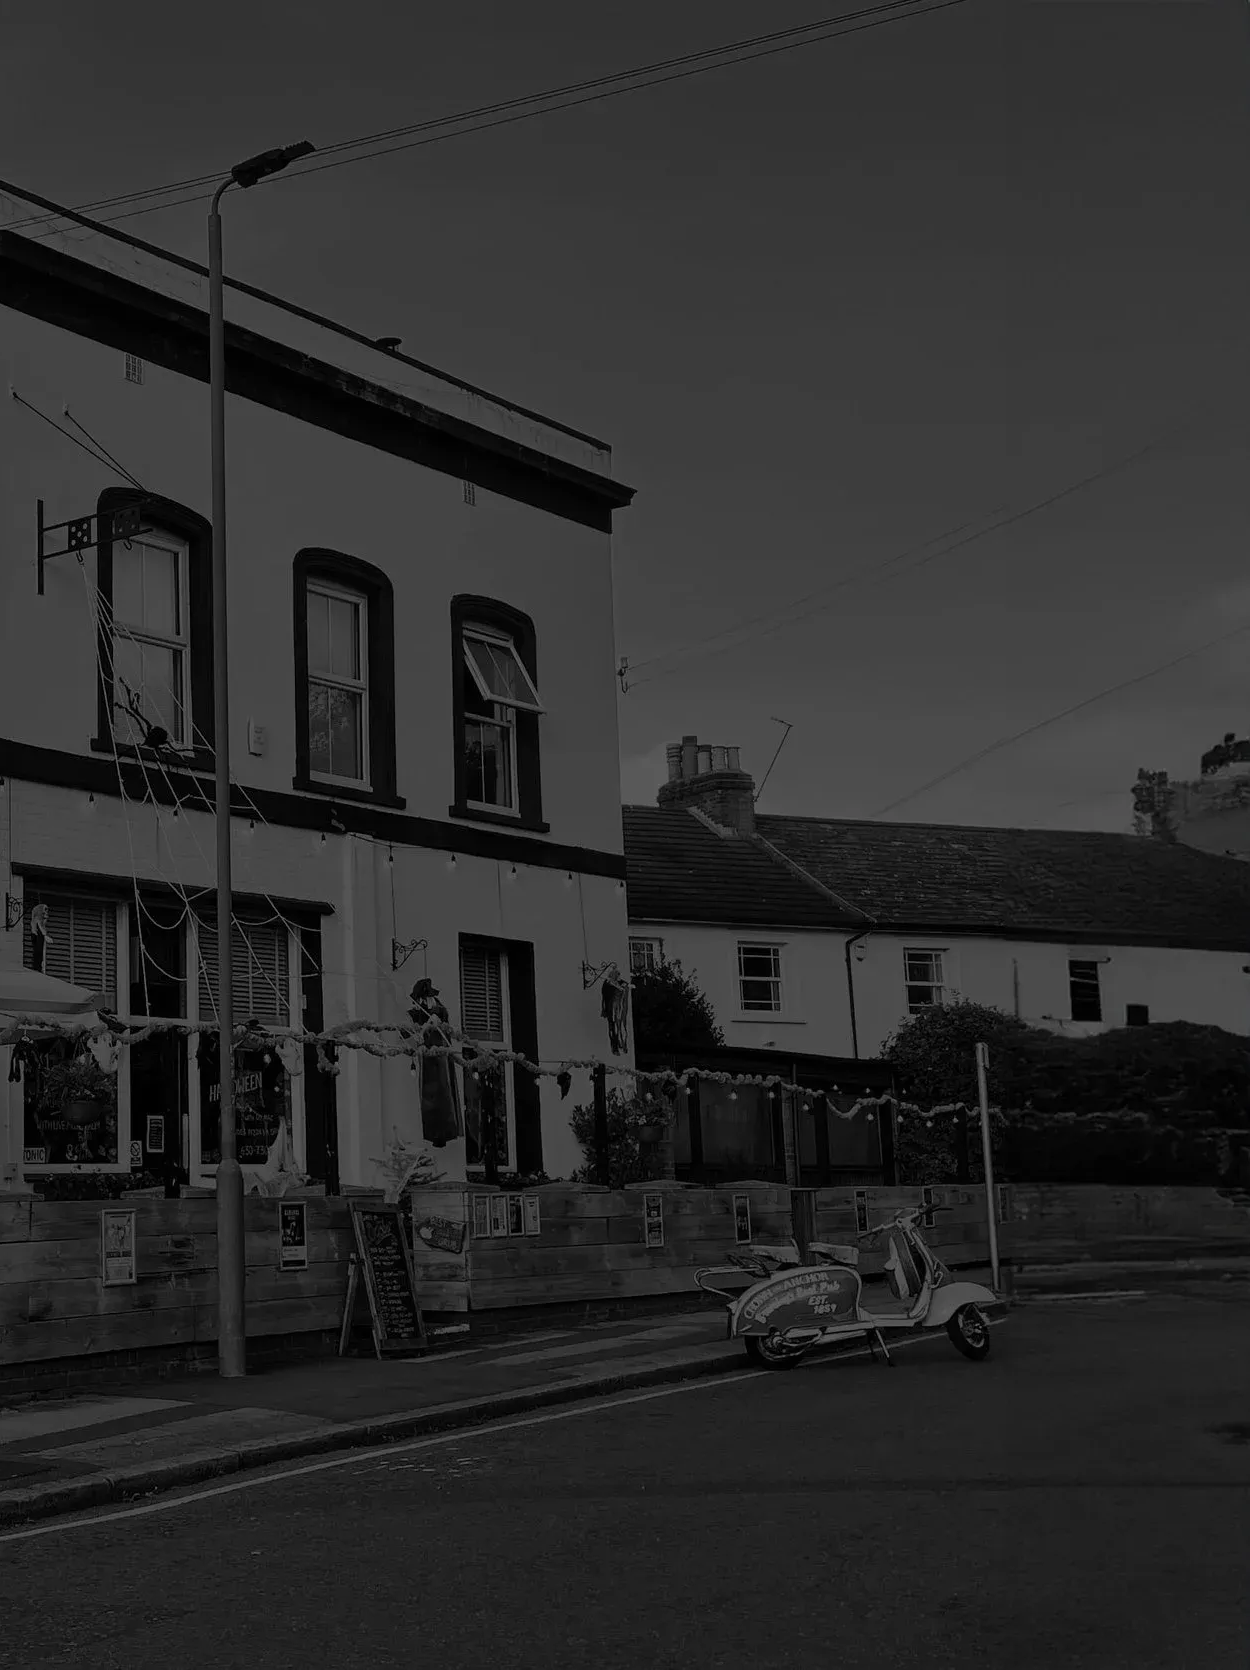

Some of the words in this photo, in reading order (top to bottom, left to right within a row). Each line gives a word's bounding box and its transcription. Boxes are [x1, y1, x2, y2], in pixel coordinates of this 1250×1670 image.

[819, 1281, 840, 1295] Pub
[744, 1288, 774, 1319] CROWN
[784, 1272, 829, 1291] ANCHOR
[808, 1294, 829, 1306] EST.
